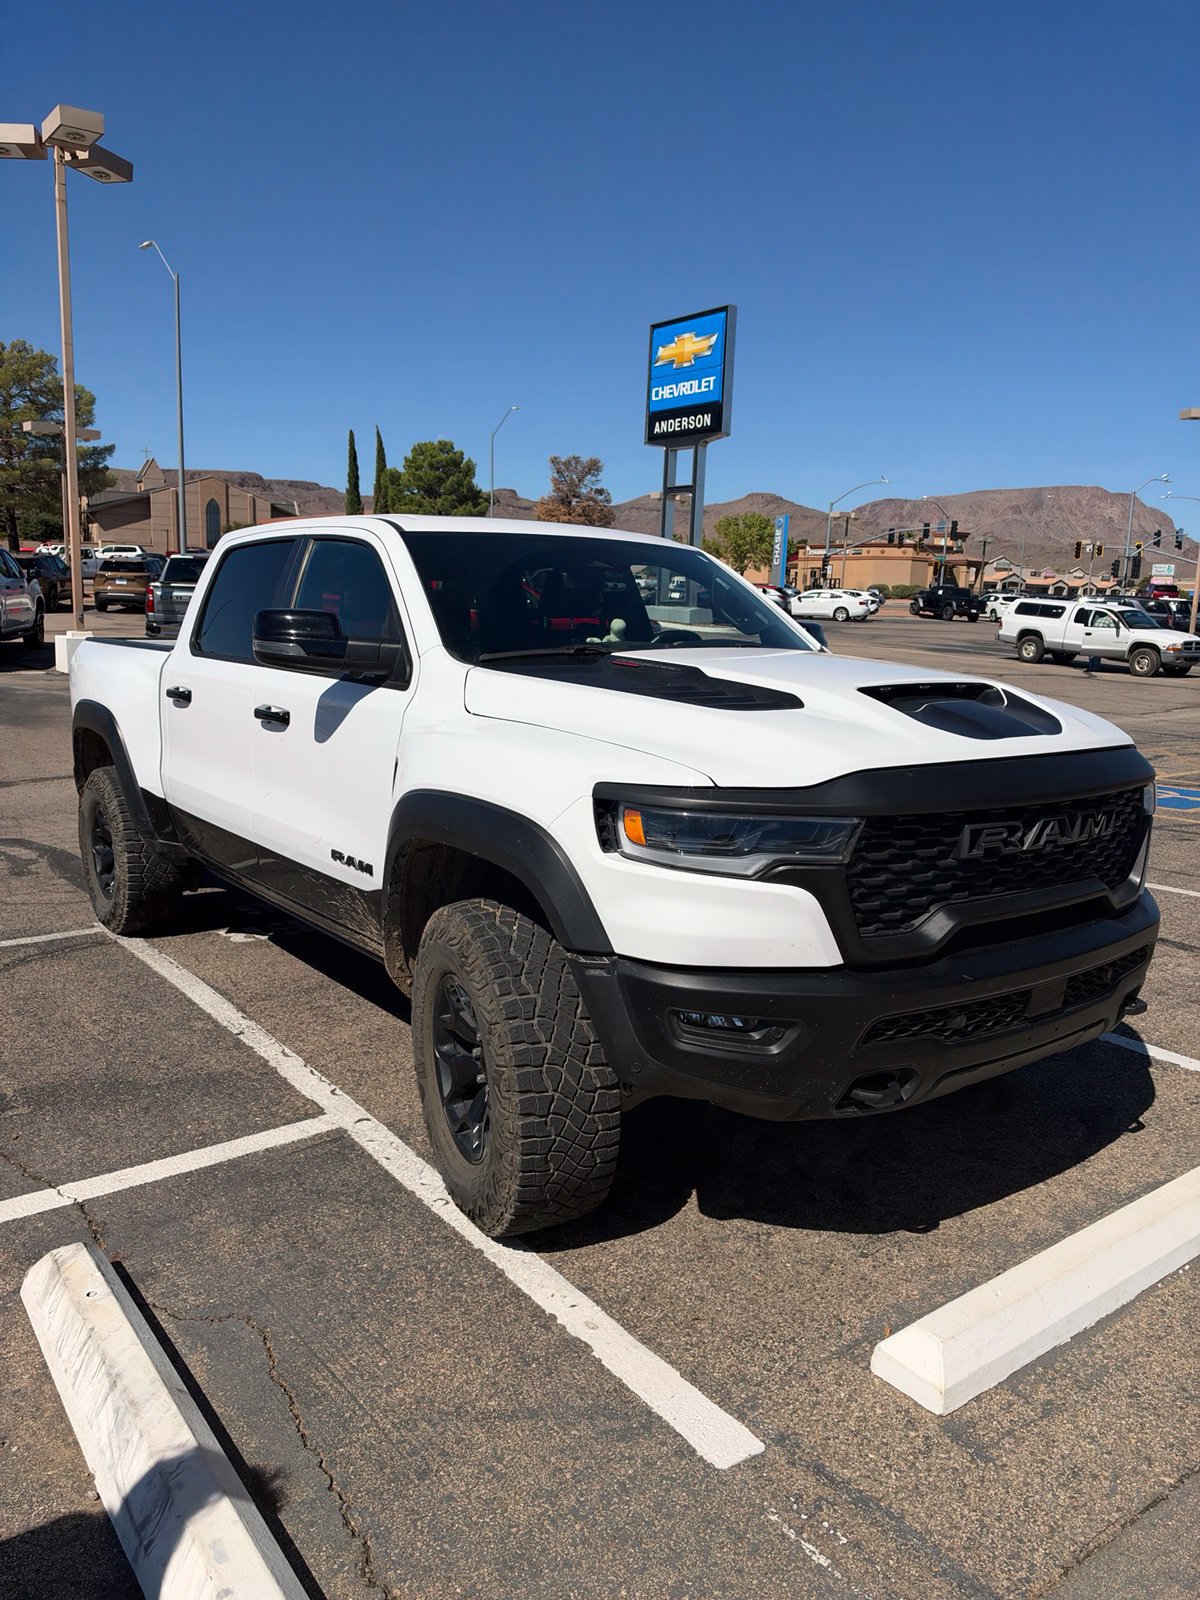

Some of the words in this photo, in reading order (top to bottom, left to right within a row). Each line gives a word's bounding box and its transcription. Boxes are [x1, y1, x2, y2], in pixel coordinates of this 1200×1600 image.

[651, 376, 716, 401] CHEVROLET
[653, 413, 711, 434] ANDERSON
[773, 528, 782, 565] CHASE
[958, 807, 1117, 859] RAM
[330, 848, 374, 877] RAM
